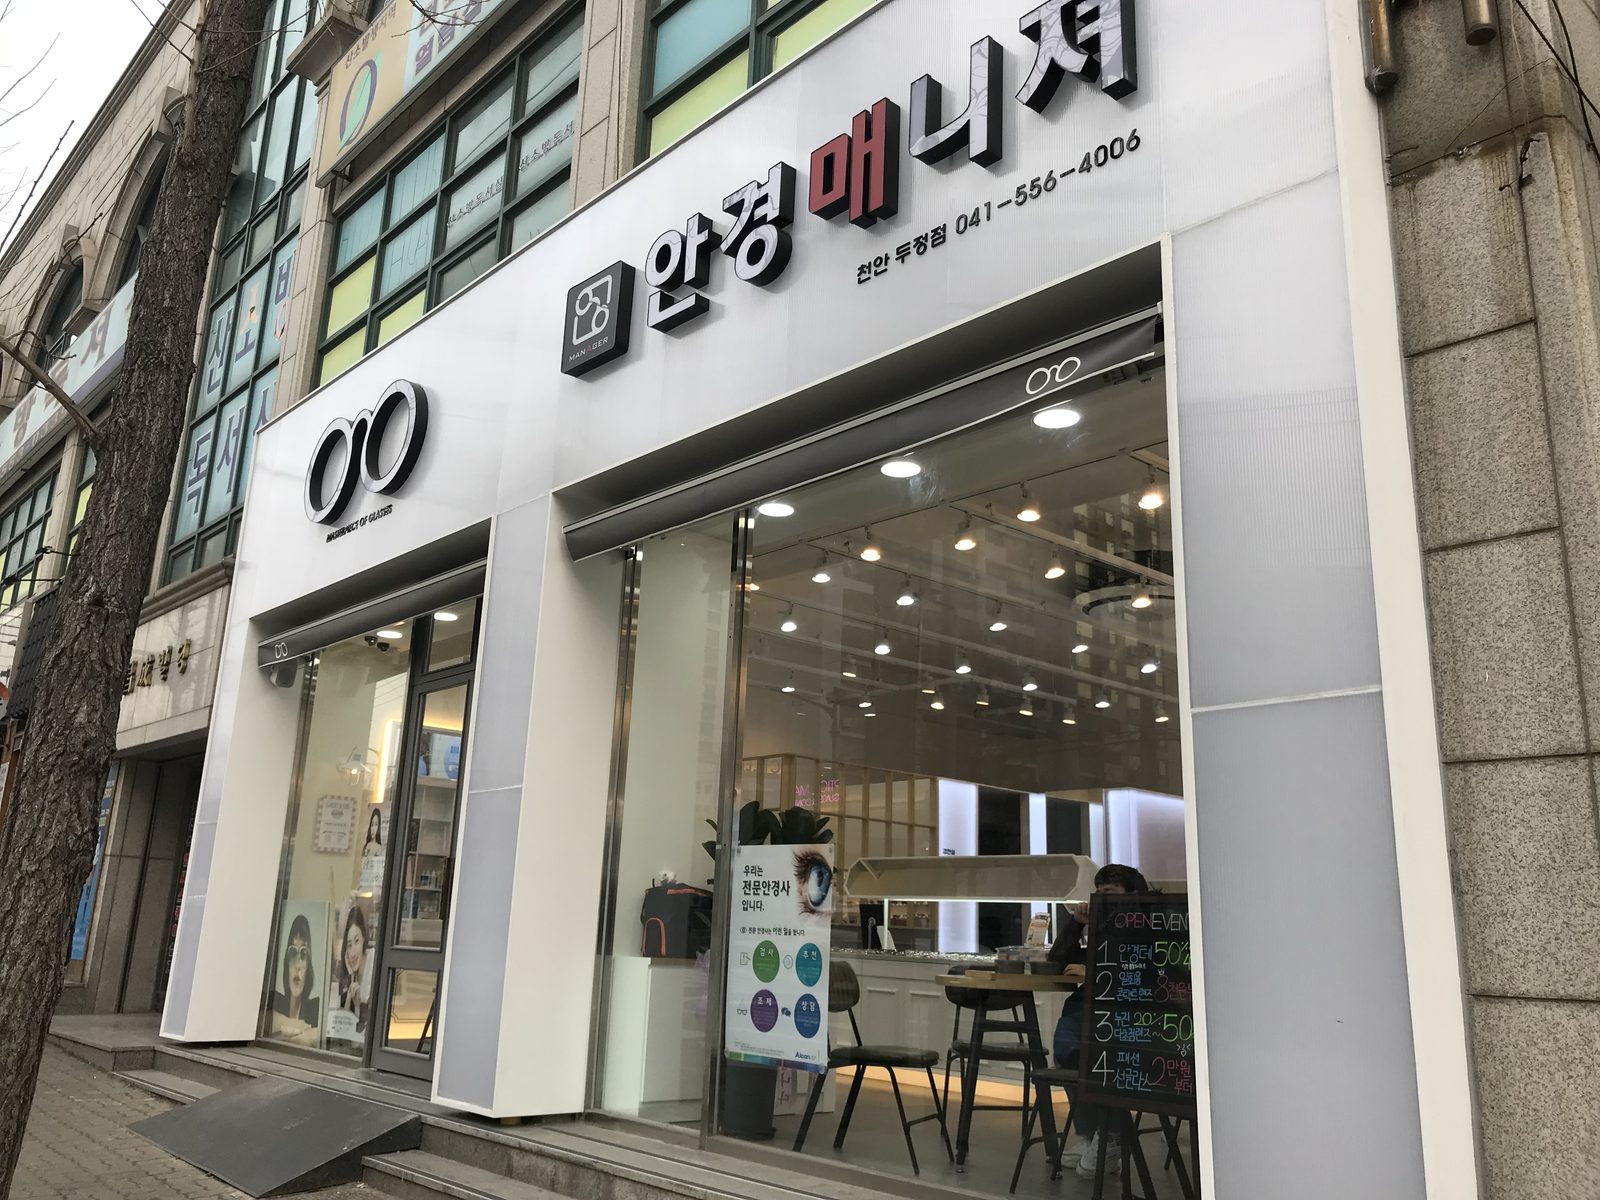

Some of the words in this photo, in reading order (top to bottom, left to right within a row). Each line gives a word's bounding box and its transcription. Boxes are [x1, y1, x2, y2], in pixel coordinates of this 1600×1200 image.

[857, 253, 890, 284] 천안
[895, 223, 947, 264] 두정점
[955, 128, 1141, 235] 041-556-4006
[568, 336, 609, 362] MANAGER
[360, 515, 369, 527] OF
[743, 864, 764, 877] 우리는
[742, 880, 791, 897] 전문안경사
[741, 899, 765, 912] 입니다.
[1096, 940, 1118, 966] 1
[1095, 970, 1116, 1001] 2
[1094, 1010, 1114, 1042] 3
[1091, 1050, 1115, 1087] 4
[1116, 1051, 1141, 1067] 패션
